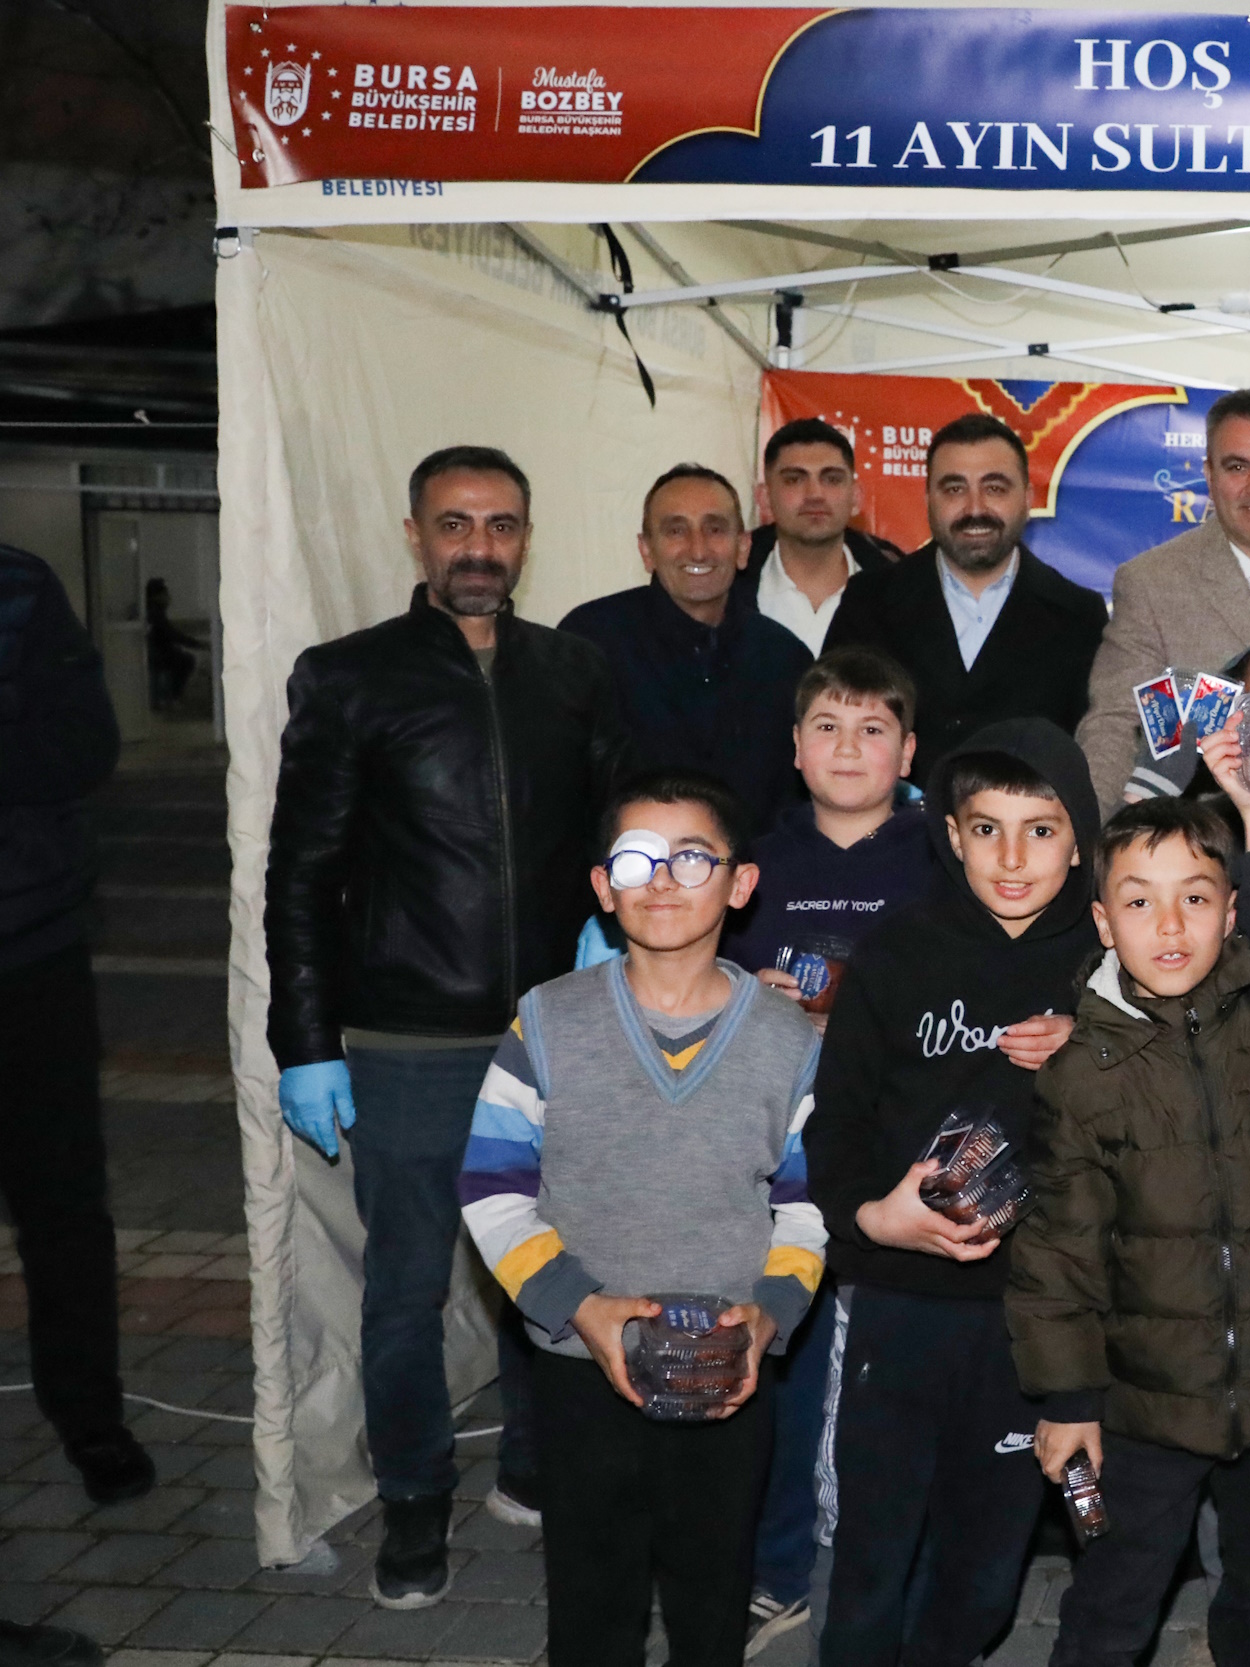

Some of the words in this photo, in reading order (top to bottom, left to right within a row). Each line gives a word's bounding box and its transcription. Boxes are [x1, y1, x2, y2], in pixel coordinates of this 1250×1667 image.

[354, 64, 478, 91] BURSA
[532, 66, 606, 94] Mustafa
[1074, 38, 1232, 109] HOŞ
[351, 89, 477, 112] BÜYÜKŞEHİR
[521, 90, 623, 111] BOZBEY
[348, 110, 476, 132] BELEDİYESİ
[518, 124, 570, 134] BELEDİYE
[573, 126, 622, 136] BAŞKANI
[519, 115, 555, 124] BURSA
[557, 114, 622, 127] BÜYÜKŞEHİR
[810, 124, 877, 168] 11
[893, 121, 1074, 171] AYIN
[883, 425, 932, 447] BUR
[883, 445, 928, 461] BÜYÜK
[786, 900, 831, 911] SACRED
[832, 899, 849, 911] MY
[1002, 1432, 1035, 1446] NIKE
